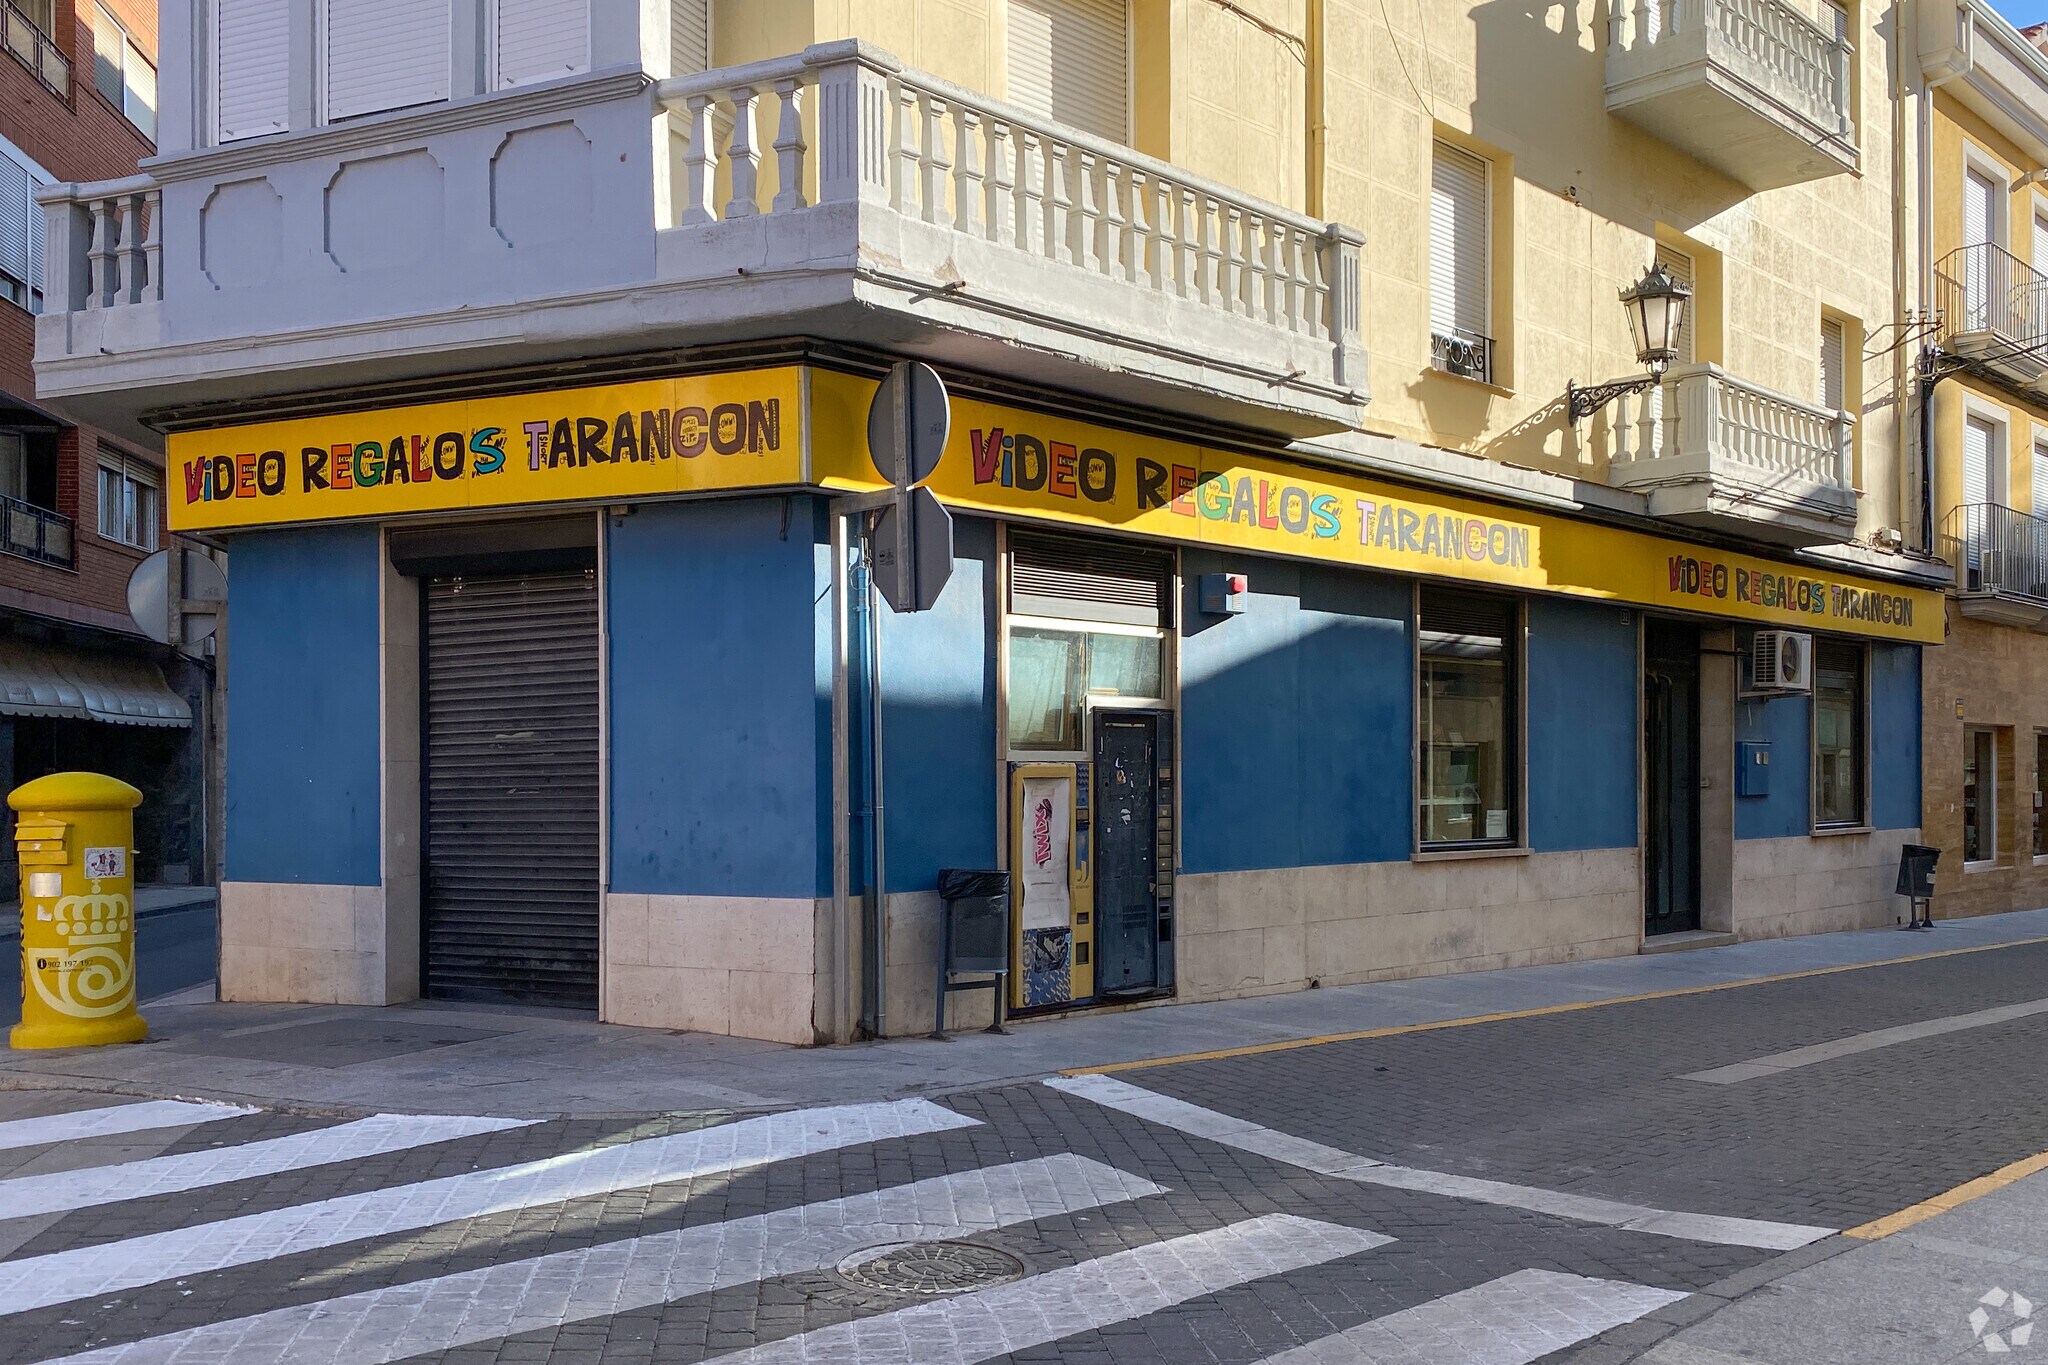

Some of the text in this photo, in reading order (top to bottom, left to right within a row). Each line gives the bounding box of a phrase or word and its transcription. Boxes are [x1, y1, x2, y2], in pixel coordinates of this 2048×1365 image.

[301, 427, 506, 493] REGALOS
[523, 398, 780, 471] TARANCON
[1136, 457, 1341, 538] REGALOS
[1356, 499, 1529, 568] TARANCON
[1736, 567, 1825, 613] REGALOS
[1831, 585, 1912, 626] TARANCON
[64, 960, 77, 968] 197
